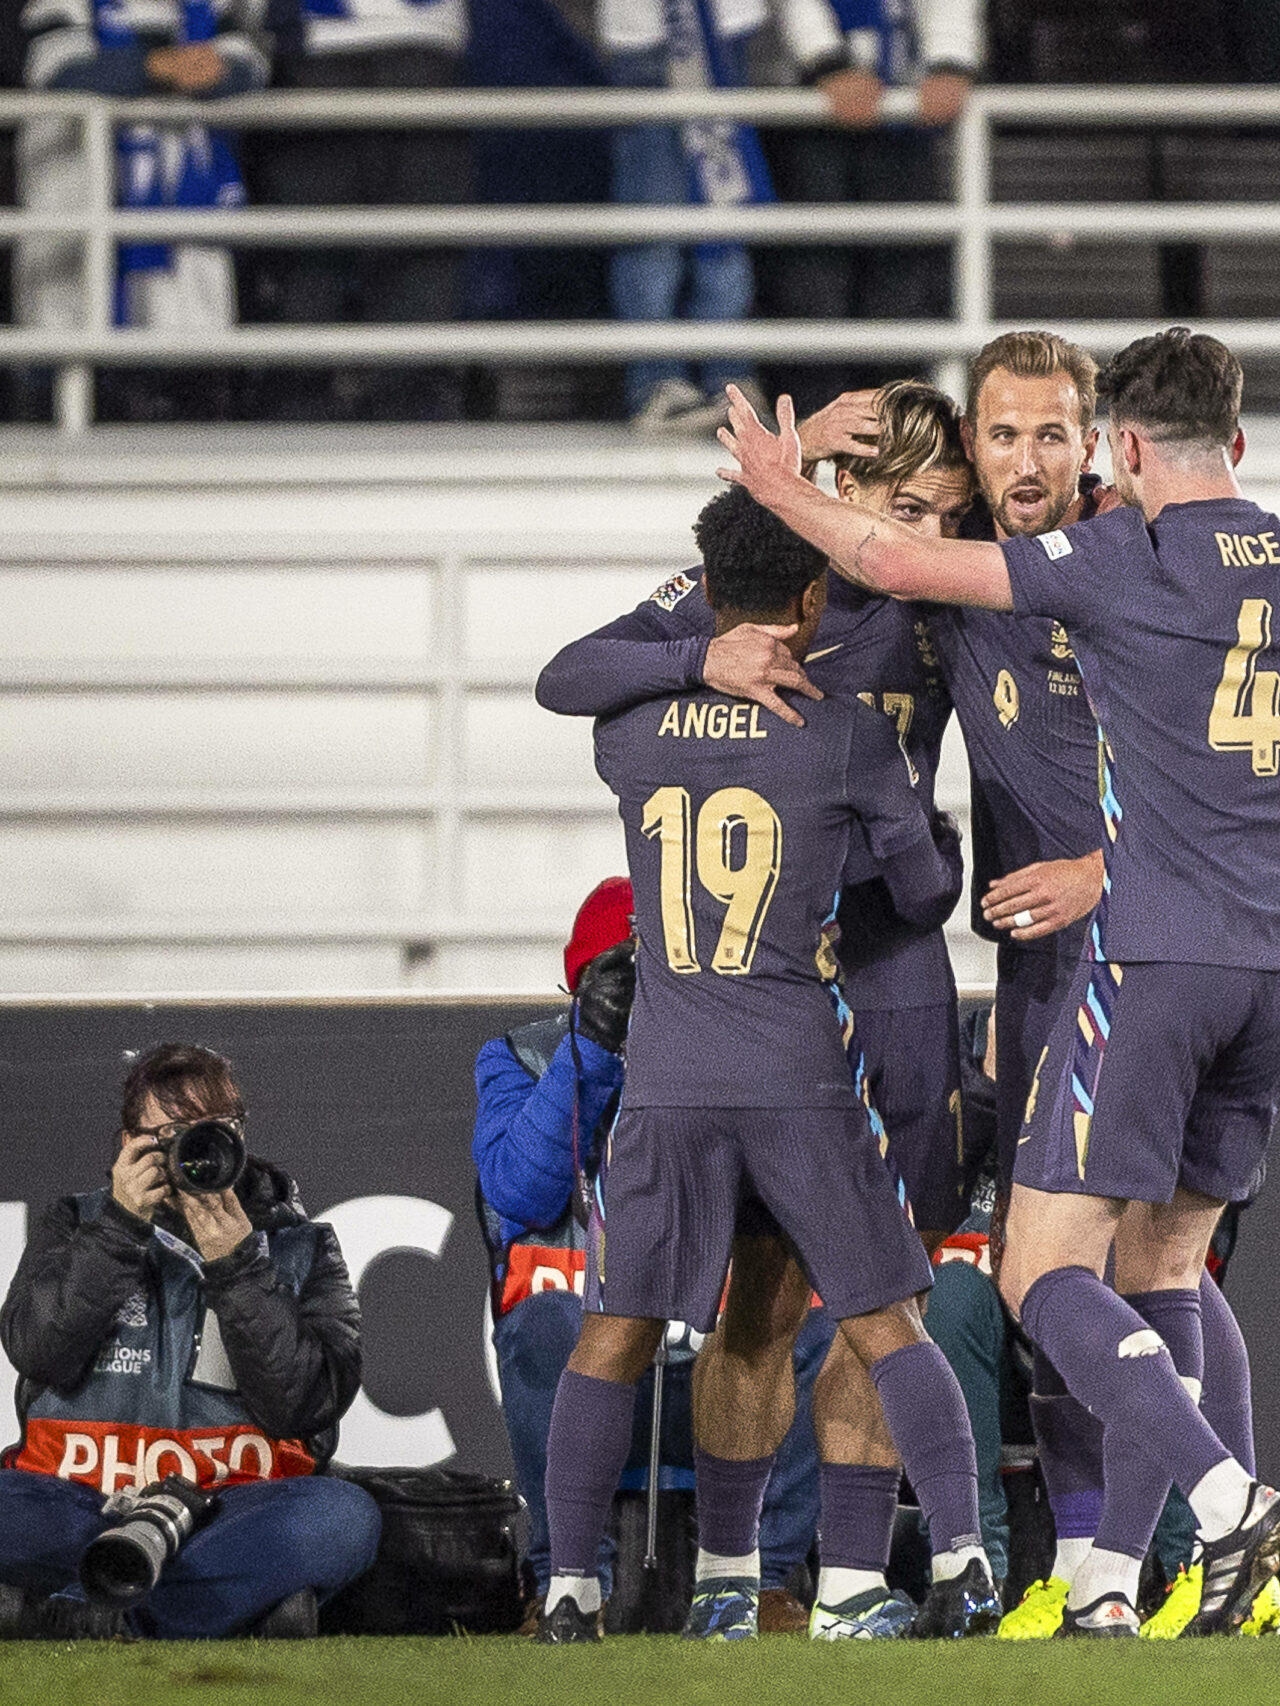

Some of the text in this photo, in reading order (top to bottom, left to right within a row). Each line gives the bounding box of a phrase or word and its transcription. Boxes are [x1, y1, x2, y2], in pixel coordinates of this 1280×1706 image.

[657, 700, 768, 739] ANGEL
[641, 786, 783, 975] 19
[58, 1433, 273, 1496] PHOTO
